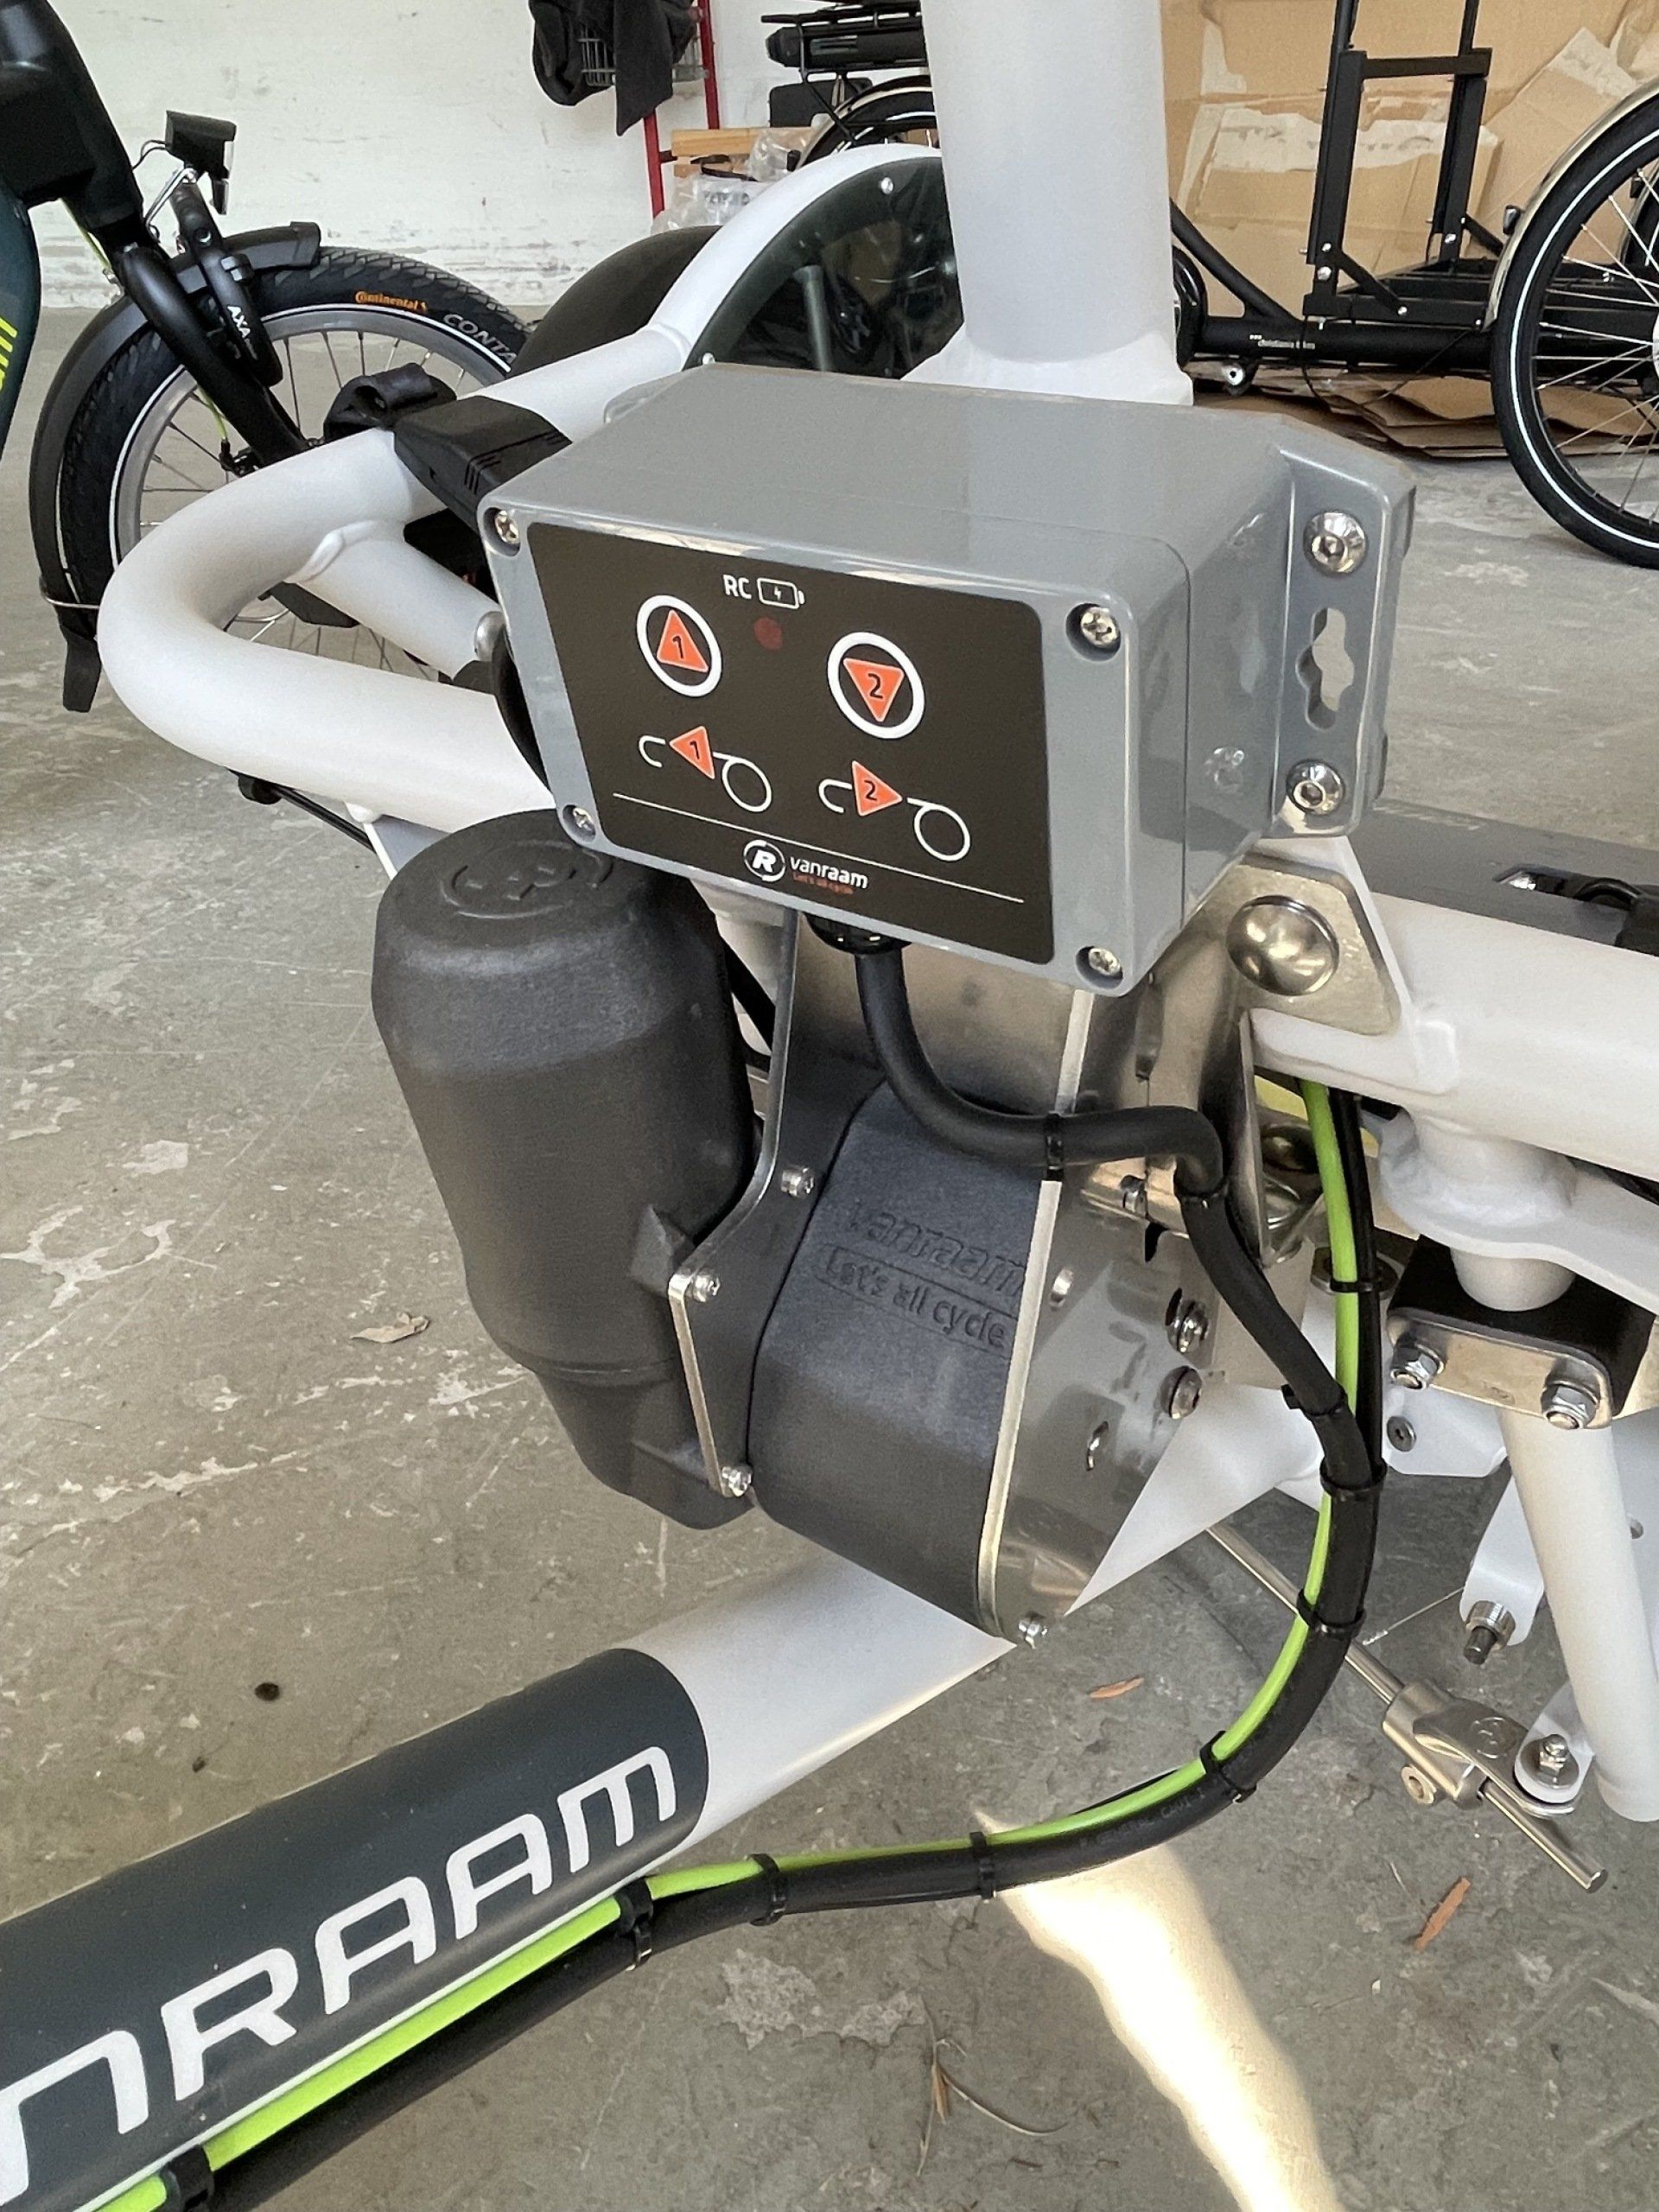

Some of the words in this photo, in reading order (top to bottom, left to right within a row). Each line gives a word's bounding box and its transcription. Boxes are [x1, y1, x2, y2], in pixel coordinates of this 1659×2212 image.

[354, 290, 418, 312] Continental
[226, 305, 251, 339] AXA
[442, 314, 518, 365] CONTA
[722, 574, 753, 600] RC
[671, 635, 684, 659] 1
[867, 672, 884, 700] 2
[689, 740, 701, 760] 1
[863, 779, 878, 802] 2
[789, 855, 869, 890] vanraam
[893, 1281, 931, 1316] all
[932, 1300, 1006, 1349] cycle
